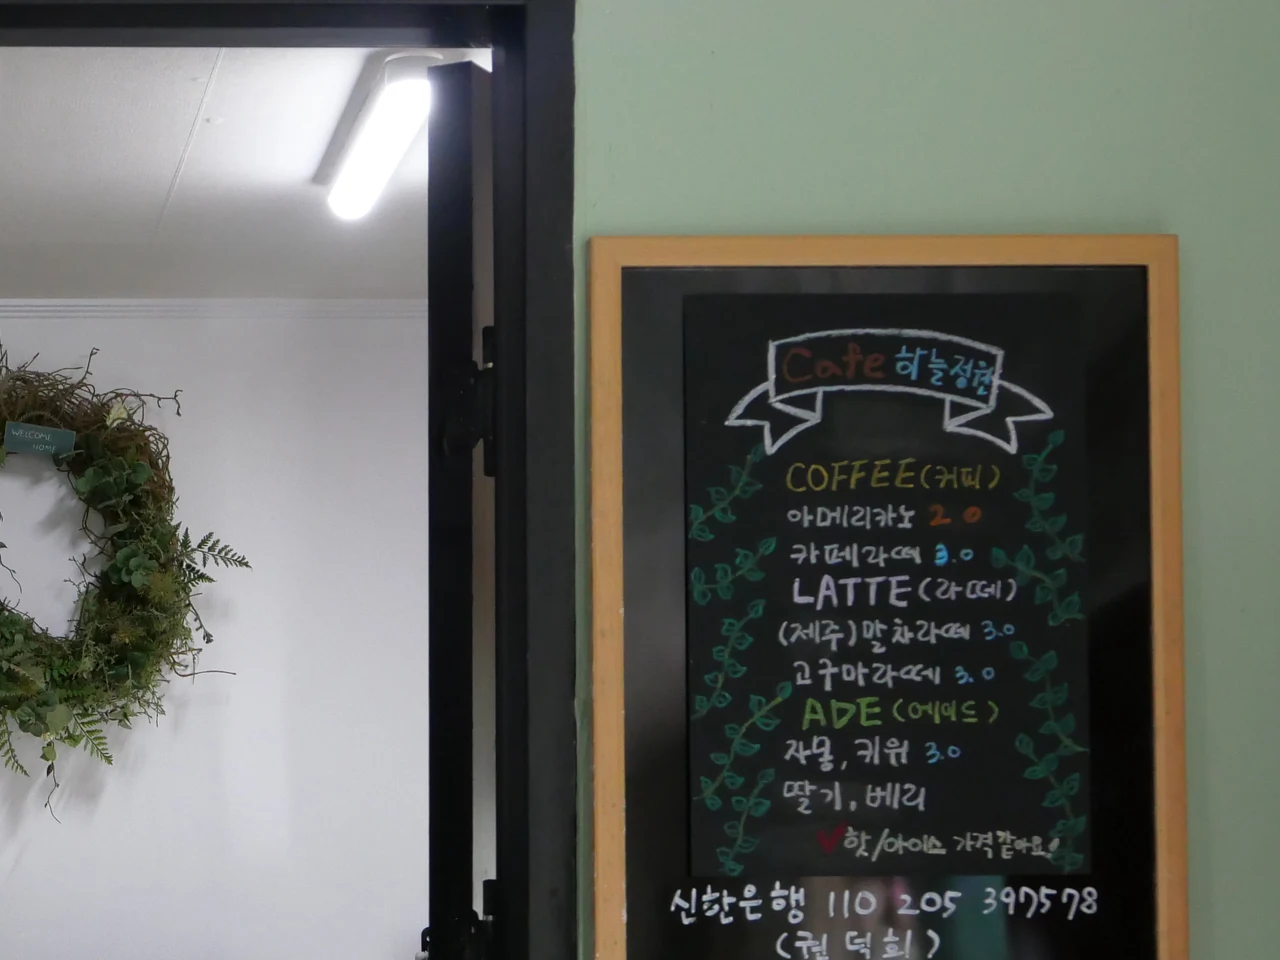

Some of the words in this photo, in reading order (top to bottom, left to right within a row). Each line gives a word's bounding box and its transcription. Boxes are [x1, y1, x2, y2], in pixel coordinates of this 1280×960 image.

[782, 341, 886, 384] Cafe
[11, 428, 53, 442] WELCOME
[32, 443, 57, 453] HOME
[786, 504, 916, 530] 아메리카노
[789, 543, 922, 568] 카페라떼
[981, 620, 1016, 641] 3.0
[793, 658, 942, 691] 고구마라떼
[853, 735, 910, 767] 키위
[924, 741, 962, 764] 3.0
[865, 781, 927, 812] 베리
[670, 881, 807, 925] 신한은행
[827, 889, 879, 918] 110
[896, 890, 963, 919] 205
[982, 886, 1099, 921] 397578
